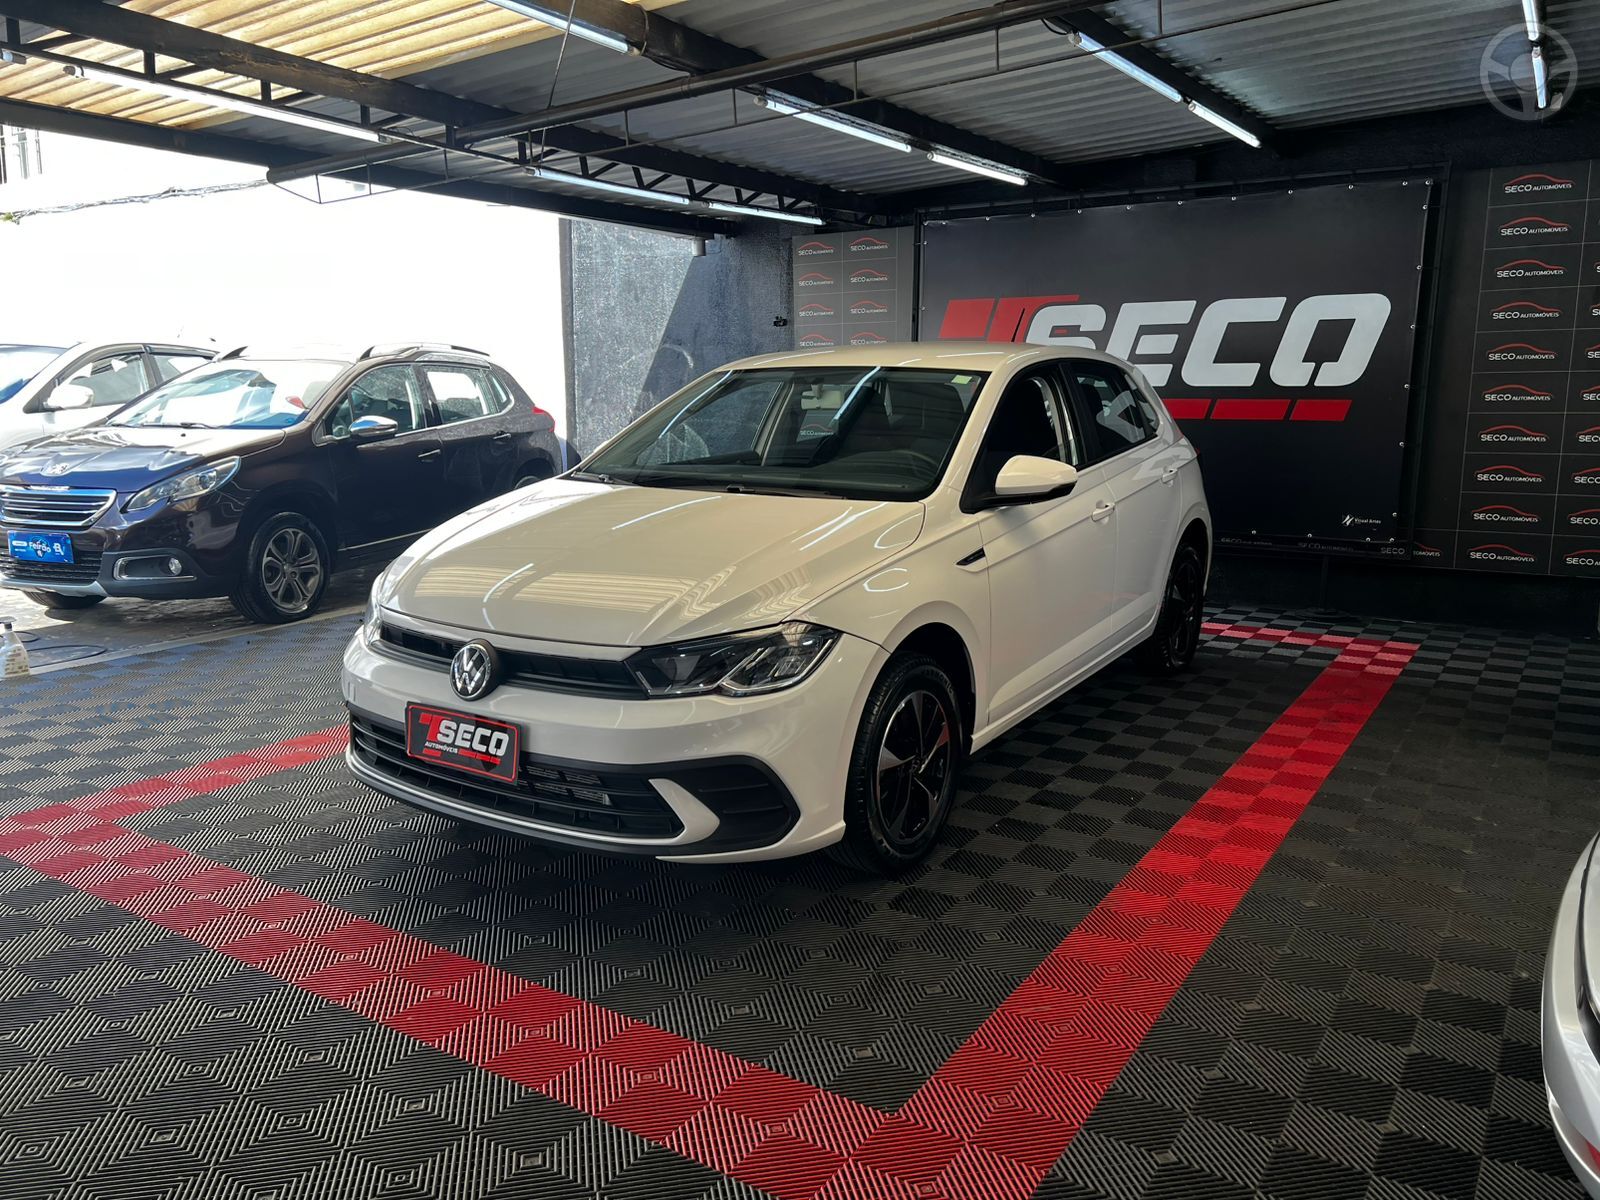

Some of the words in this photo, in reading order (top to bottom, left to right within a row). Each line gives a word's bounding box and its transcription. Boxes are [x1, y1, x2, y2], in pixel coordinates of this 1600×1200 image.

[1505, 184, 1532, 193] SECO
[1532, 182, 1572, 191] AUTOMÓVEIS
[1500, 227, 1528, 236] SECO
[1528, 225, 1568, 234] AUTOMÓVEIS
[1496, 269, 1524, 278] SECO
[1524, 268, 1564, 277] AUTOMÓVEIS
[1492, 311, 1520, 320] SECO
[1520, 310, 1560, 318] AUTOMÓVEIS
[1025, 293, 1391, 387] SECO
[1488, 353, 1516, 361] SECO
[1516, 352, 1555, 360] AUTOMÓVEIS
[1480, 434, 1508, 442] SECO
[1507, 434, 1546, 442] AUTOMÓVEIS
[1477, 473, 1504, 481] SECO
[1504, 475, 1542, 483] AUTOMÓVEIS
[1473, 513, 1500, 521] SECO
[1570, 516, 1598, 525] SECO
[1470, 551, 1497, 560] SECO
[1566, 557, 1594, 566] SECO
